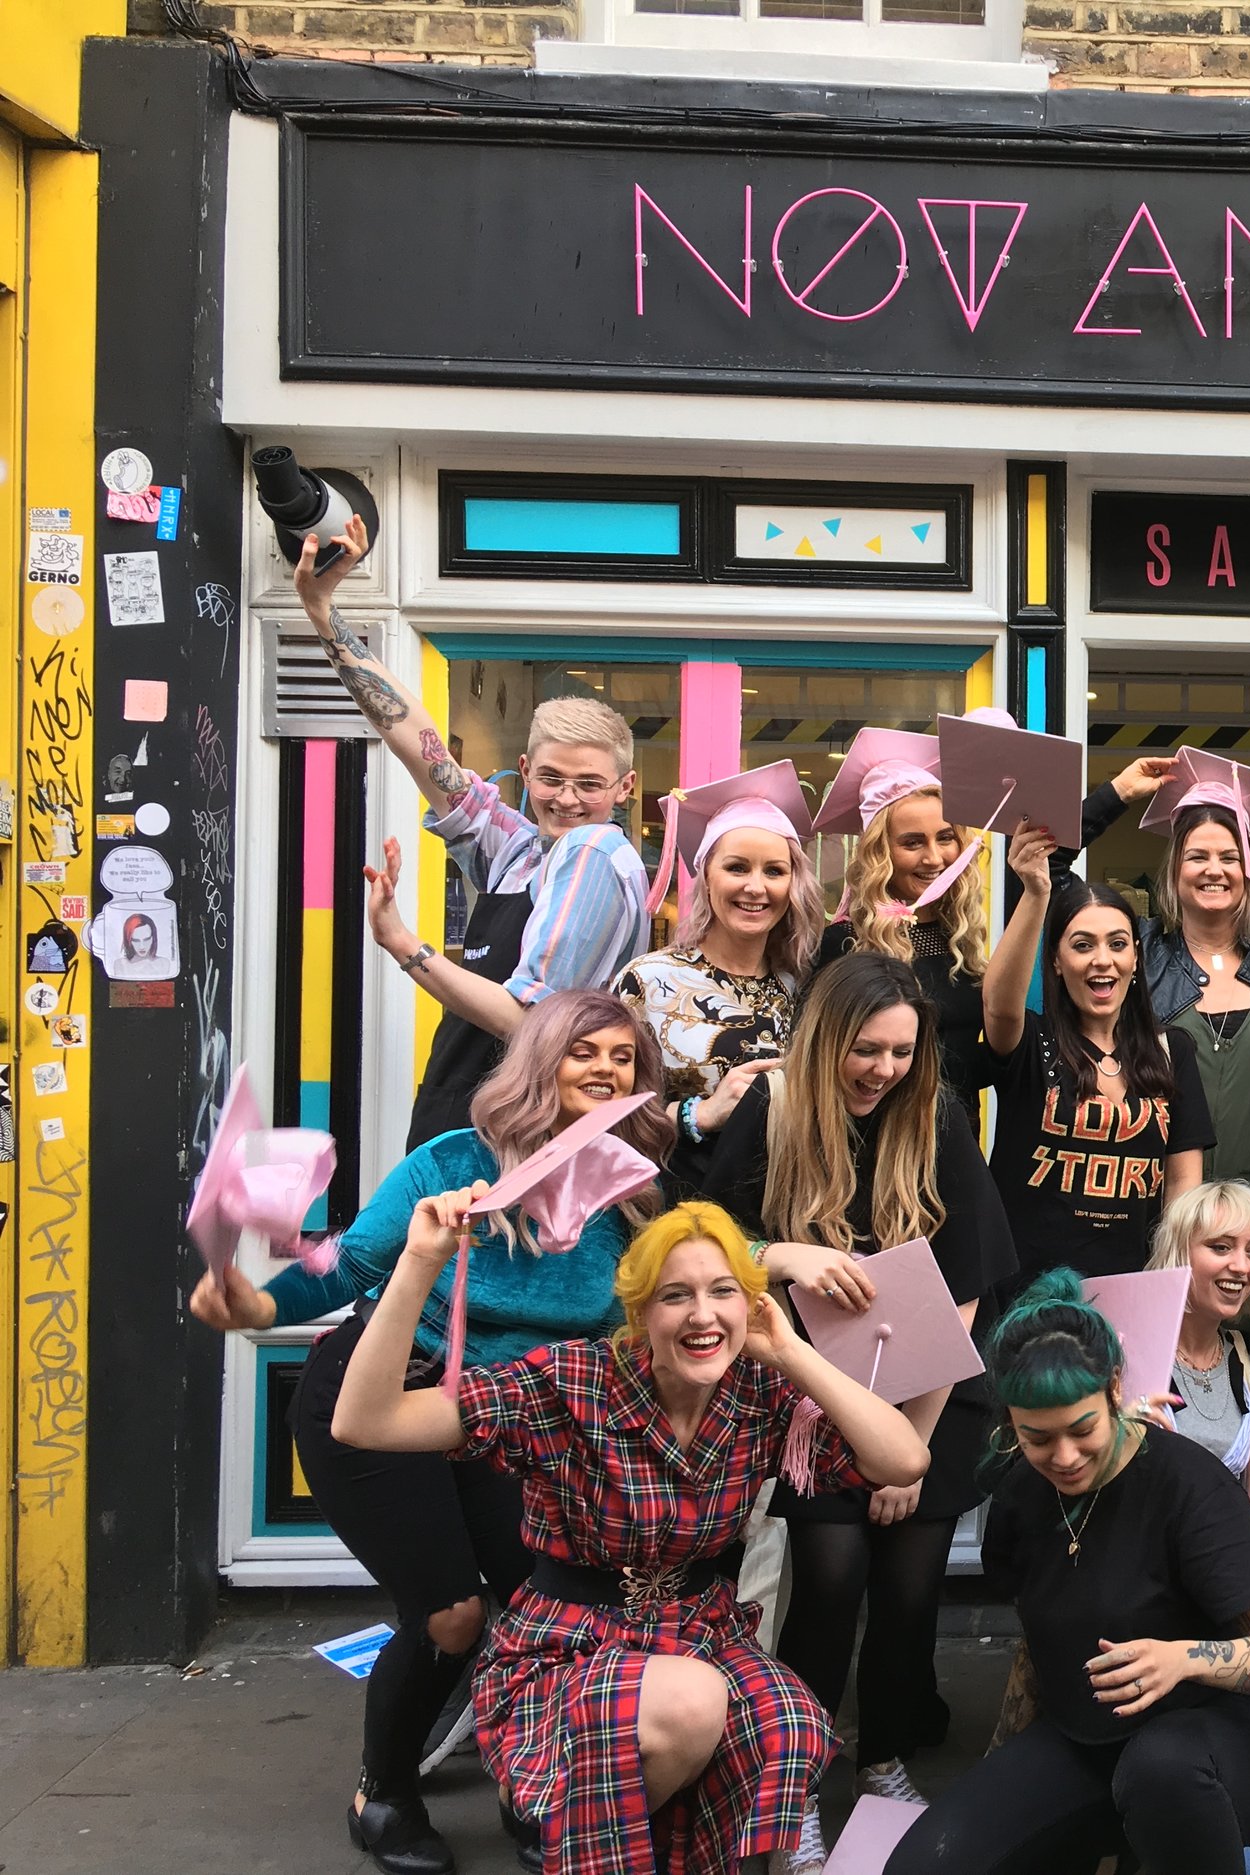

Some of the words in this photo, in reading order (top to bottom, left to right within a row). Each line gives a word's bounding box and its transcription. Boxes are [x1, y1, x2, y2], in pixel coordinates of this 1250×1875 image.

[635, 182, 1029, 333] NOT
[163, 494, 179, 534] HNRX
[28, 571, 80, 585] GERNO
[62, 904, 85, 919] SAID
